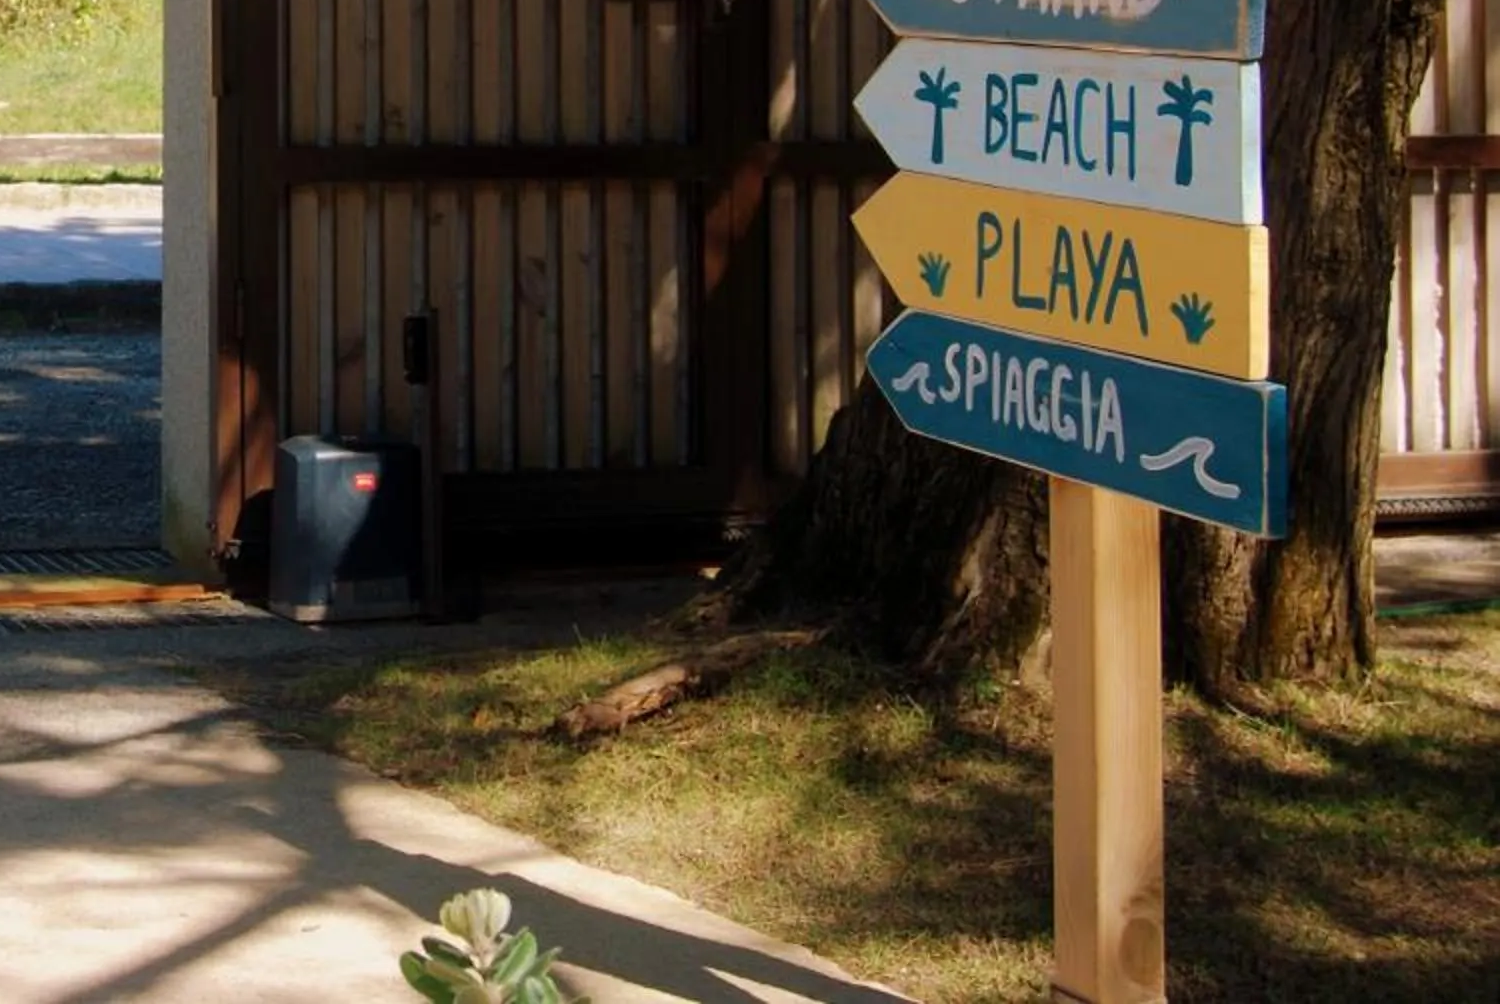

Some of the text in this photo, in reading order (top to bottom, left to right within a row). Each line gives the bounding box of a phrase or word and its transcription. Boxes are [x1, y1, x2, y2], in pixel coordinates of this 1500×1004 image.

[984, 73, 1135, 180] BEACH
[977, 211, 1148, 336] PLAYA
[939, 343, 1125, 462] SPIAGGIA
